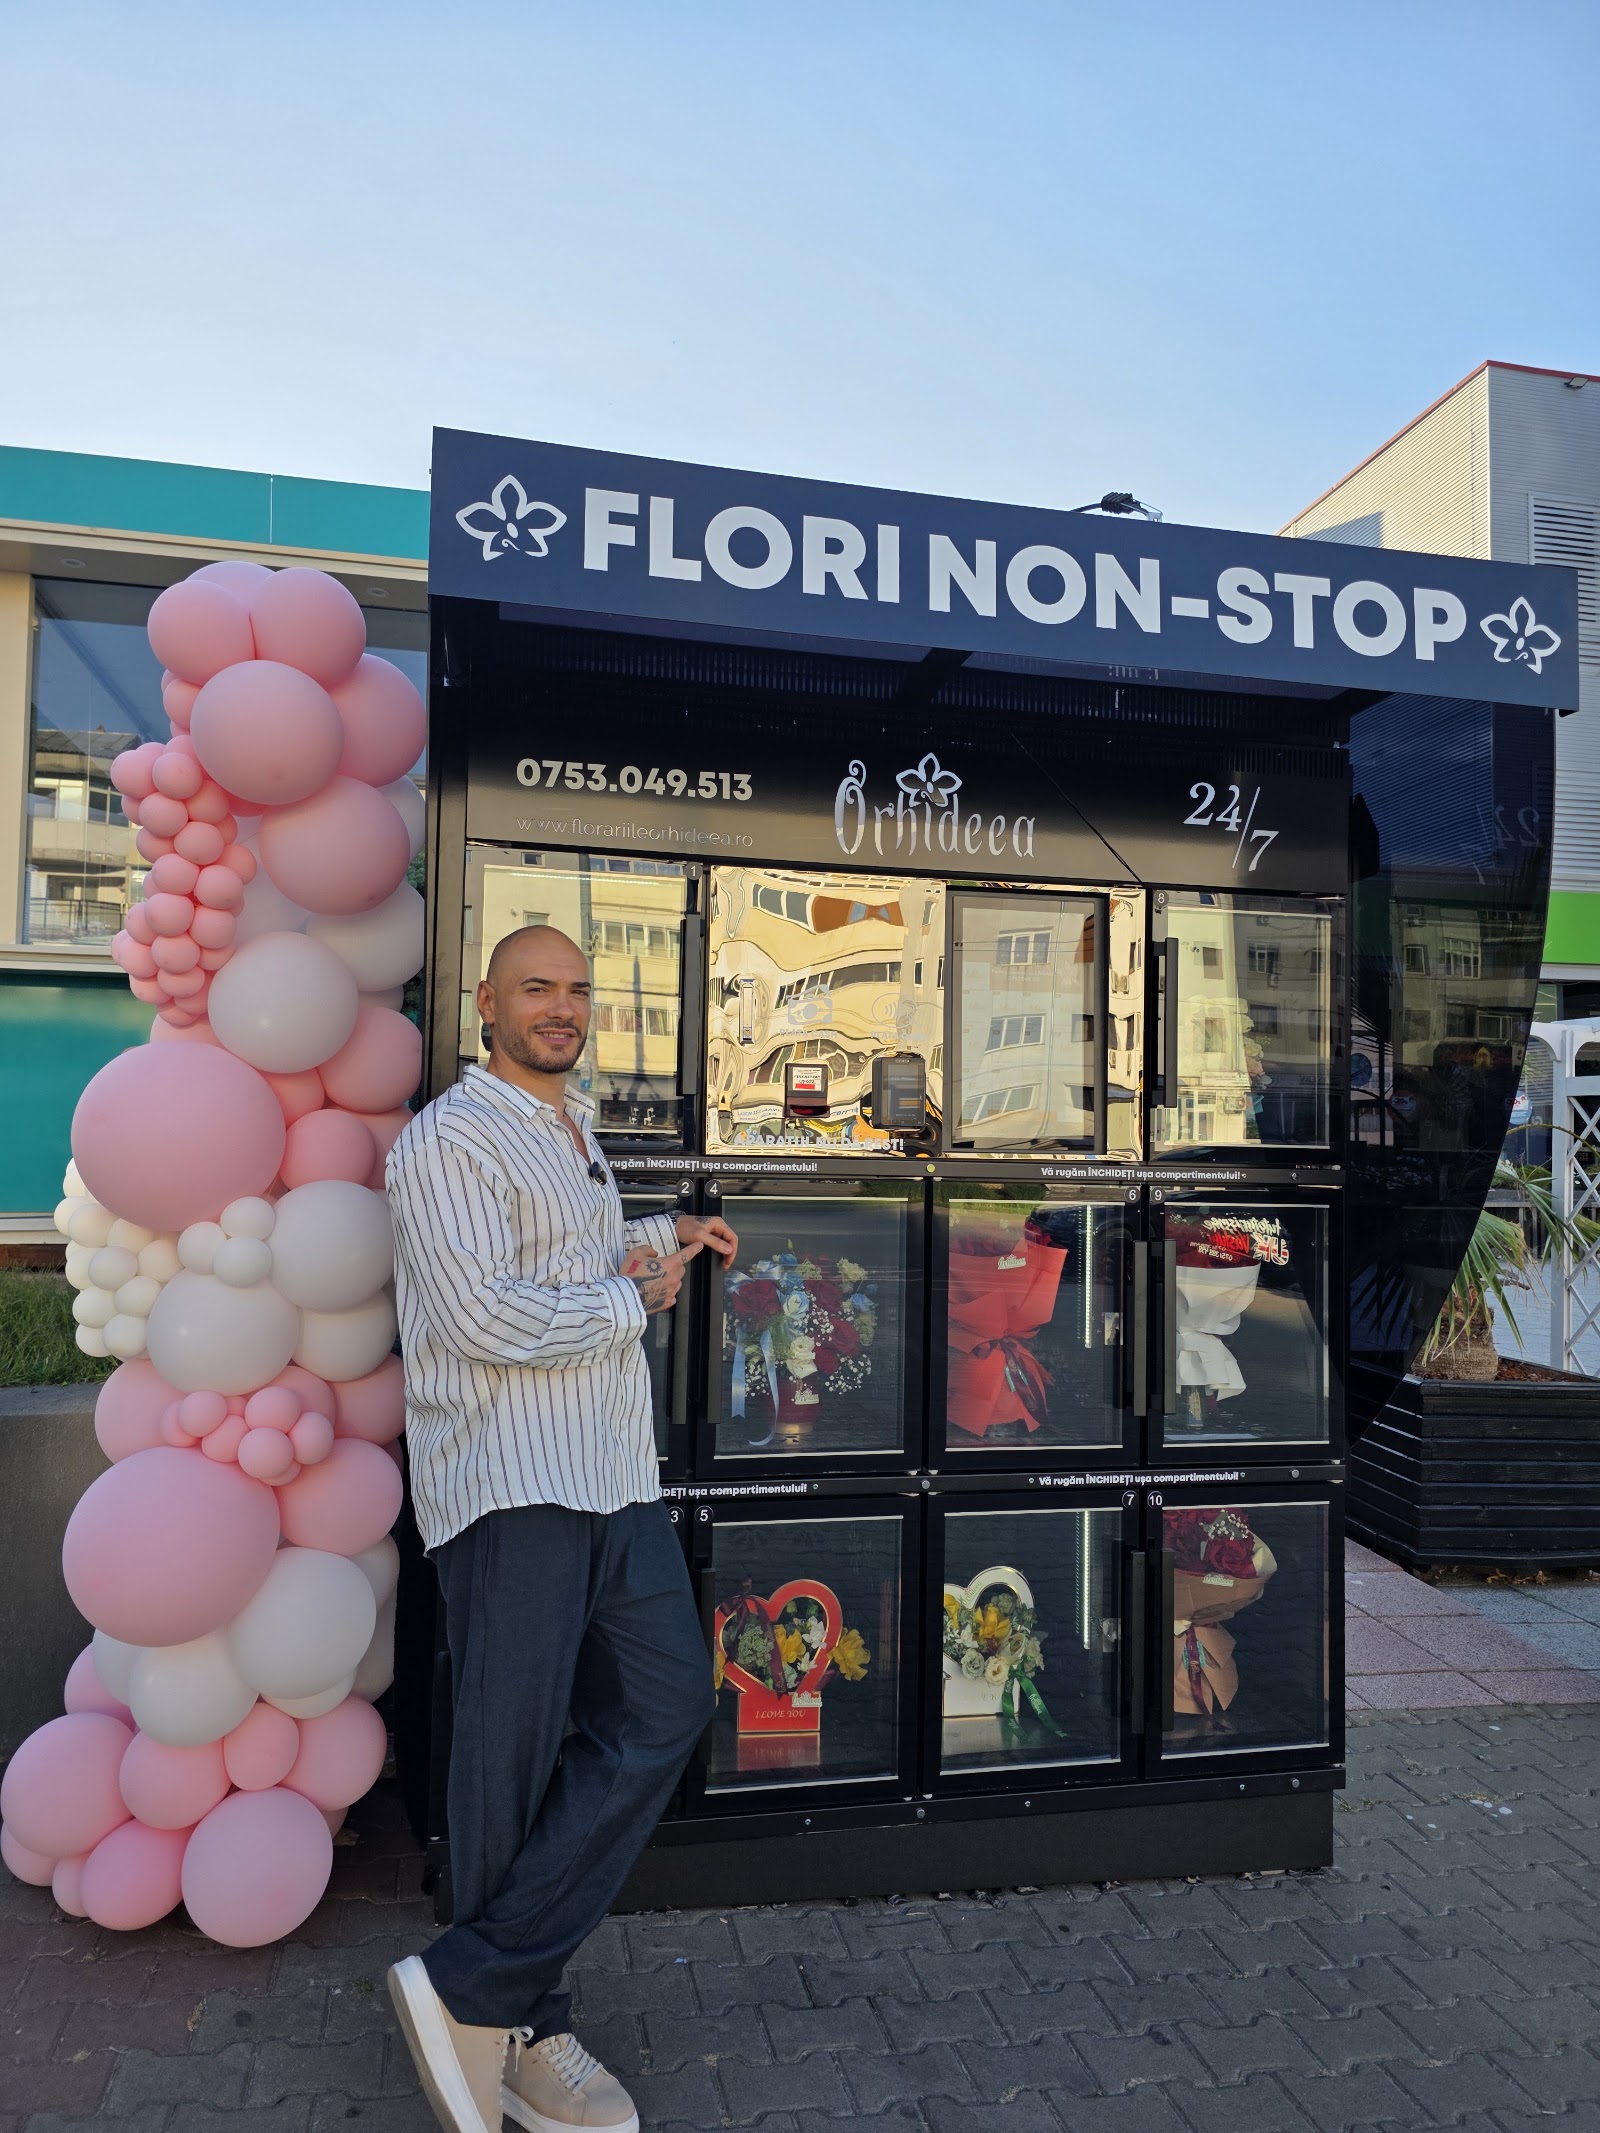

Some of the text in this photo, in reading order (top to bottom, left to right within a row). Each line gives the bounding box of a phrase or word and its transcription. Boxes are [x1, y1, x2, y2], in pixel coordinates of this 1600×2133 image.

[583, 487, 1467, 662] FLORI NON-STOP
[516, 758, 753, 801] 0753.049.513
[835, 760, 1036, 858] Orhideea
[516, 817, 754, 848] www.florariileorhideea.ro
[1184, 782, 1280, 872] 24/7
[690, 866, 696, 876] 1
[1157, 893, 1165, 904] 8
[811, 1030, 838, 1039] CASH
[816, 1136, 837, 1147] NU
[865, 1138, 904, 1151] REST!
[609, 1158, 818, 1173] rugăm ÎNCHIDEȚI ușa compartimentului!
[1041, 1166, 1241, 1181] Vă rugăm ÎNCHIDEȚI ușa compartimentului!
[681, 1182, 689, 1194] 2
[709, 1183, 718, 1194] 4
[1128, 1190, 1137, 1200] 6
[1154, 1190, 1162, 1200] 9
[1039, 1471, 1239, 1486] Vă rugăm ÎNCHIDEȚI ușa compartimentului!
[662, 1483, 808, 1499] DEȚI ușa compartimentului!
[1126, 1494, 1135, 1506] 7
[1149, 1495, 1163, 1506] 10
[670, 1510, 679, 1523] 3
[699, 1509, 709, 1522] 5
[755, 1709, 806, 1719] I LOVE YOU
